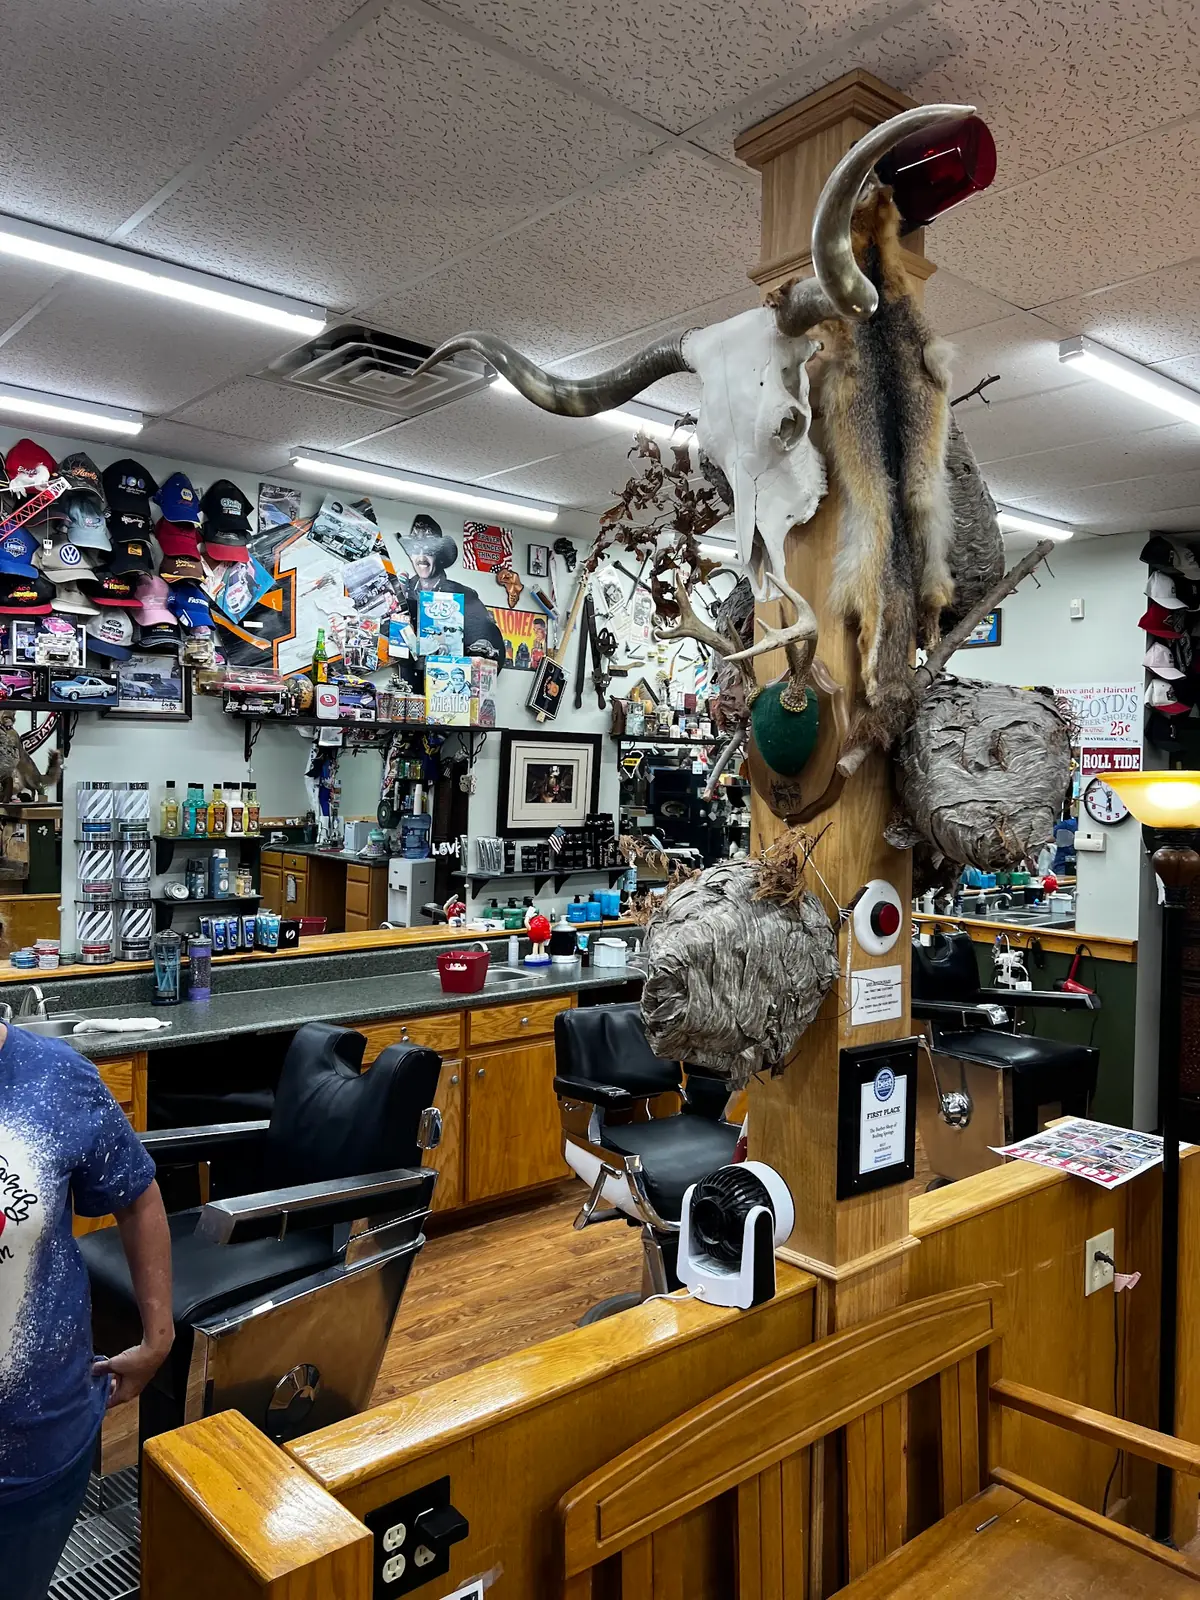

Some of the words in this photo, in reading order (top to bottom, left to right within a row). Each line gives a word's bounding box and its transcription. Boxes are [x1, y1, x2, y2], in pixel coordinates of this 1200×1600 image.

[477, 533, 500, 543] PRAYER
[475, 541, 502, 552] CHANGES
[478, 551, 500, 560] THINGS
[495, 608, 535, 637] LIONEL
[1103, 686, 1136, 694] Haircut!
[429, 695, 469, 713] WHEATIES
[1071, 694, 1138, 719] FLOYD'S
[1102, 713, 1137, 722] SHOPPE
[1083, 754, 1111, 769] ROLL
[1113, 754, 1140, 769] TIDE
[866, 1110, 883, 1120] FIRST
[883, 1106, 901, 1116] PLACE
[0, 1155, 38, 1226] amily
